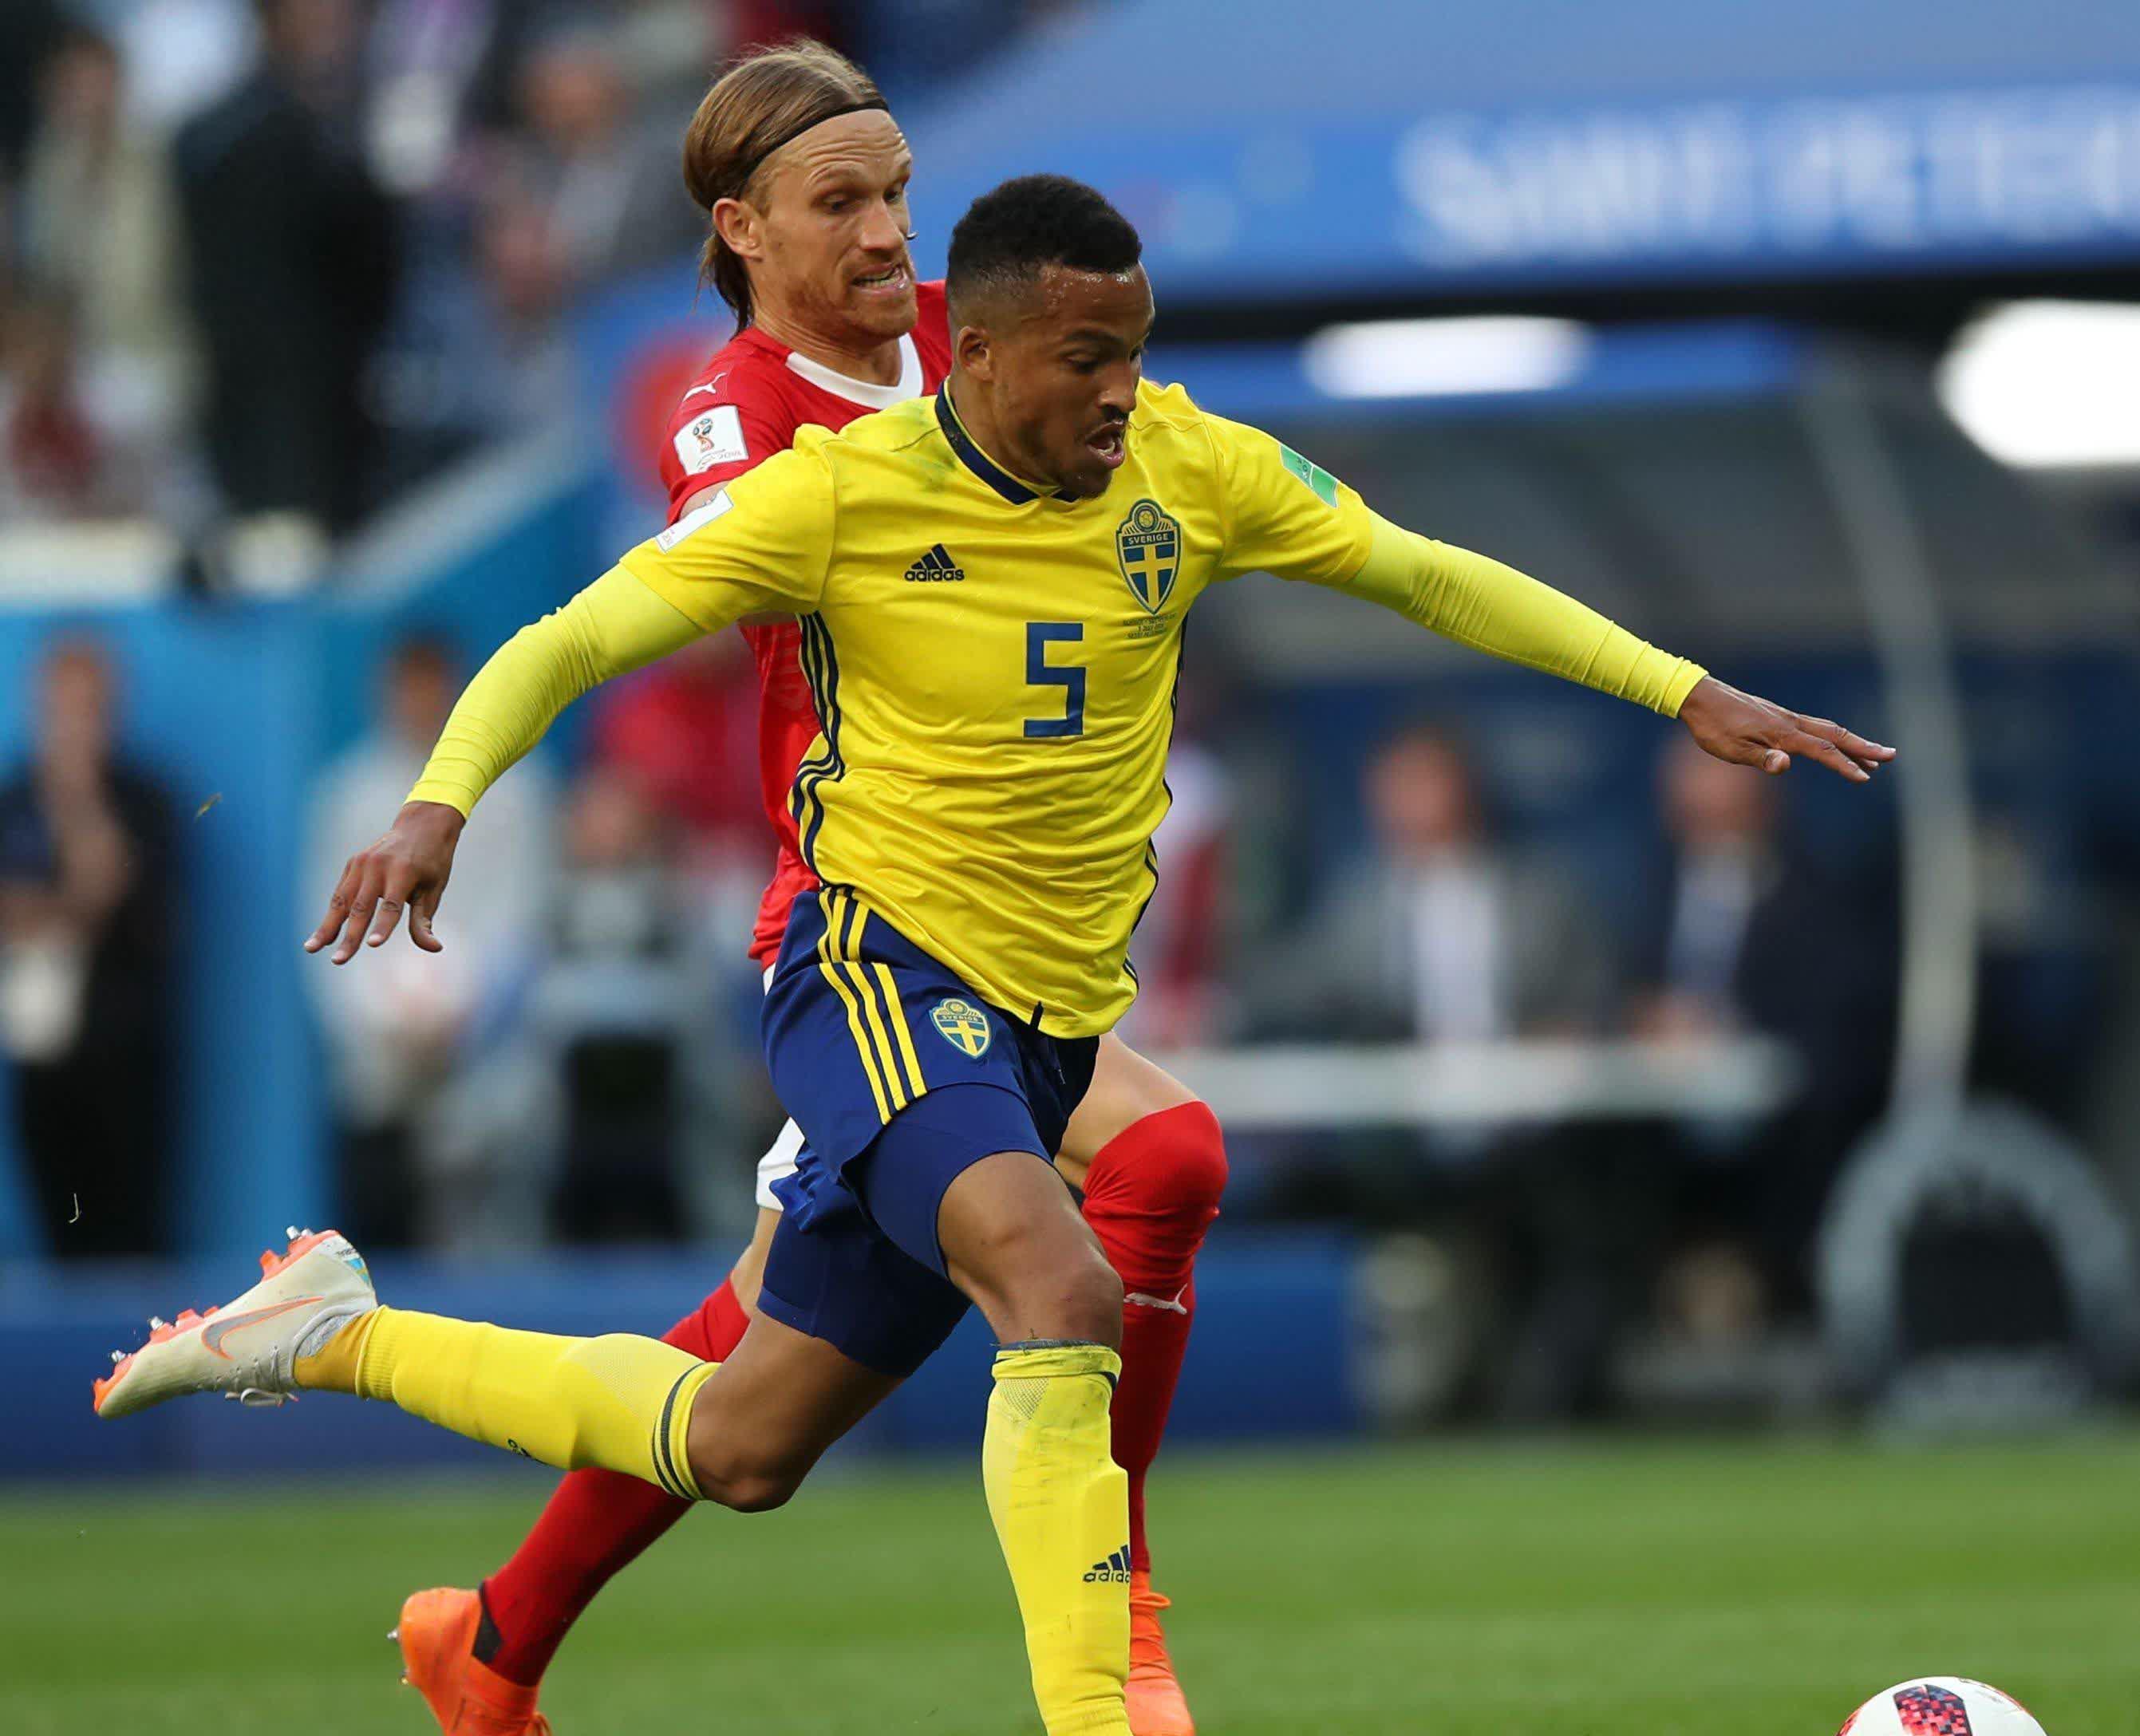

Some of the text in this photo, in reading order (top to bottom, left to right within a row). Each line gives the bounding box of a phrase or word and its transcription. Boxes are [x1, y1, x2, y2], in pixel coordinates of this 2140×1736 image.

[1127, 532, 1169, 545] SVERIGE
[904, 568, 965, 582] adidas
[1024, 622, 1086, 738] 5
